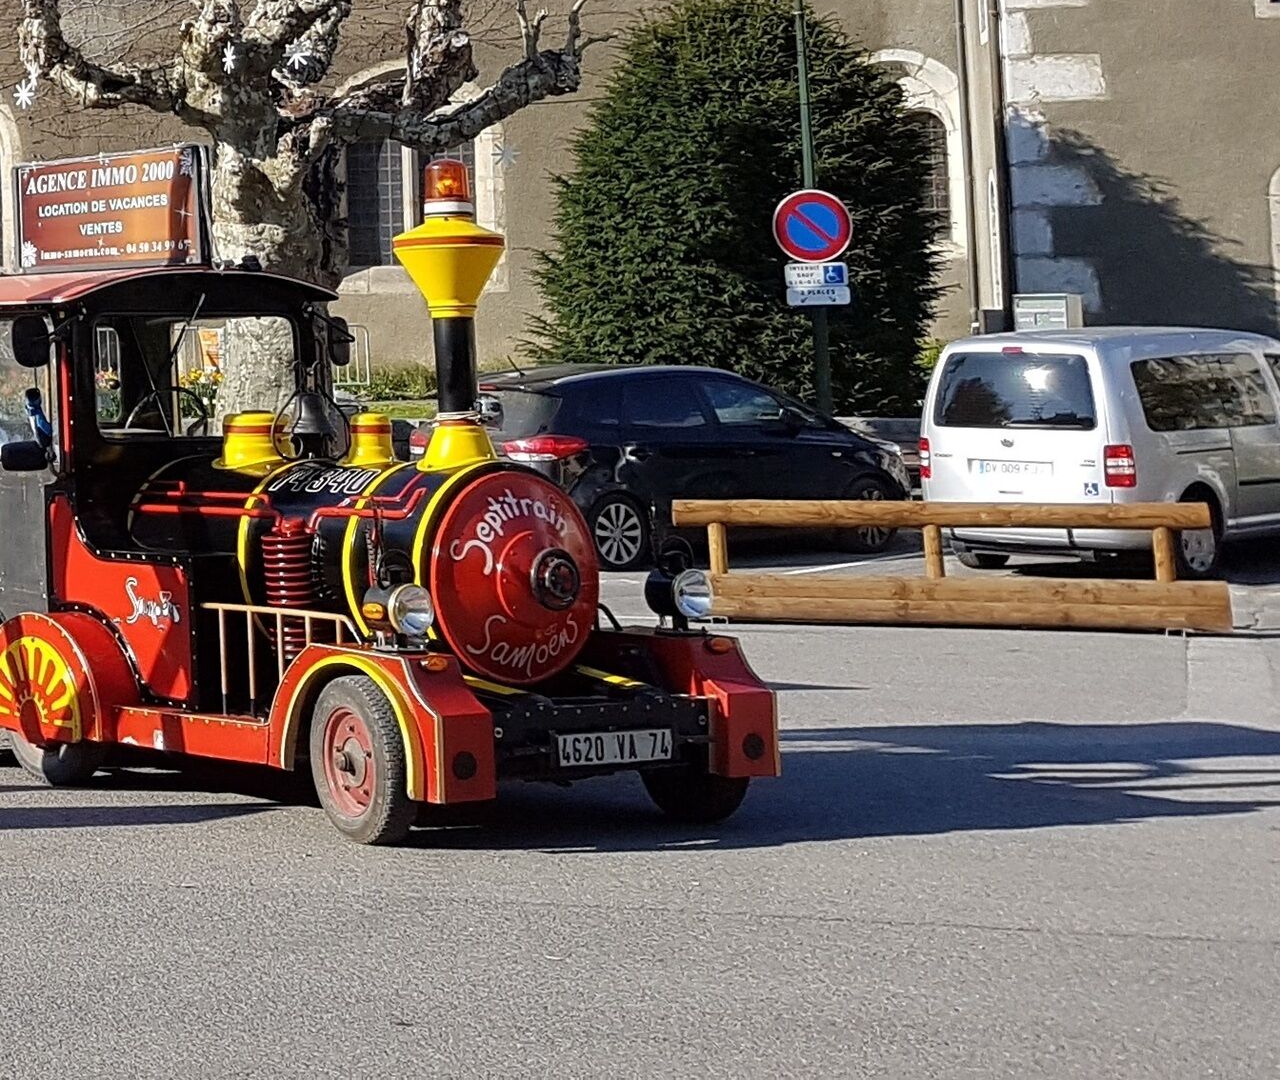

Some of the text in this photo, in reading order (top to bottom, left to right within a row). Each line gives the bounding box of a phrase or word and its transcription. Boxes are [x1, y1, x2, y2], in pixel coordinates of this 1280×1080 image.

[26, 160, 174, 195] AGENCE IMMO 2000
[38, 194, 168, 217] LOCATION DE VACANCES
[79, 221, 123, 236] VENTES
[151, 241, 162, 252] 34
[449, 488, 569, 576] Septitrain
[562, 731, 669, 764] 4620 VA 74
